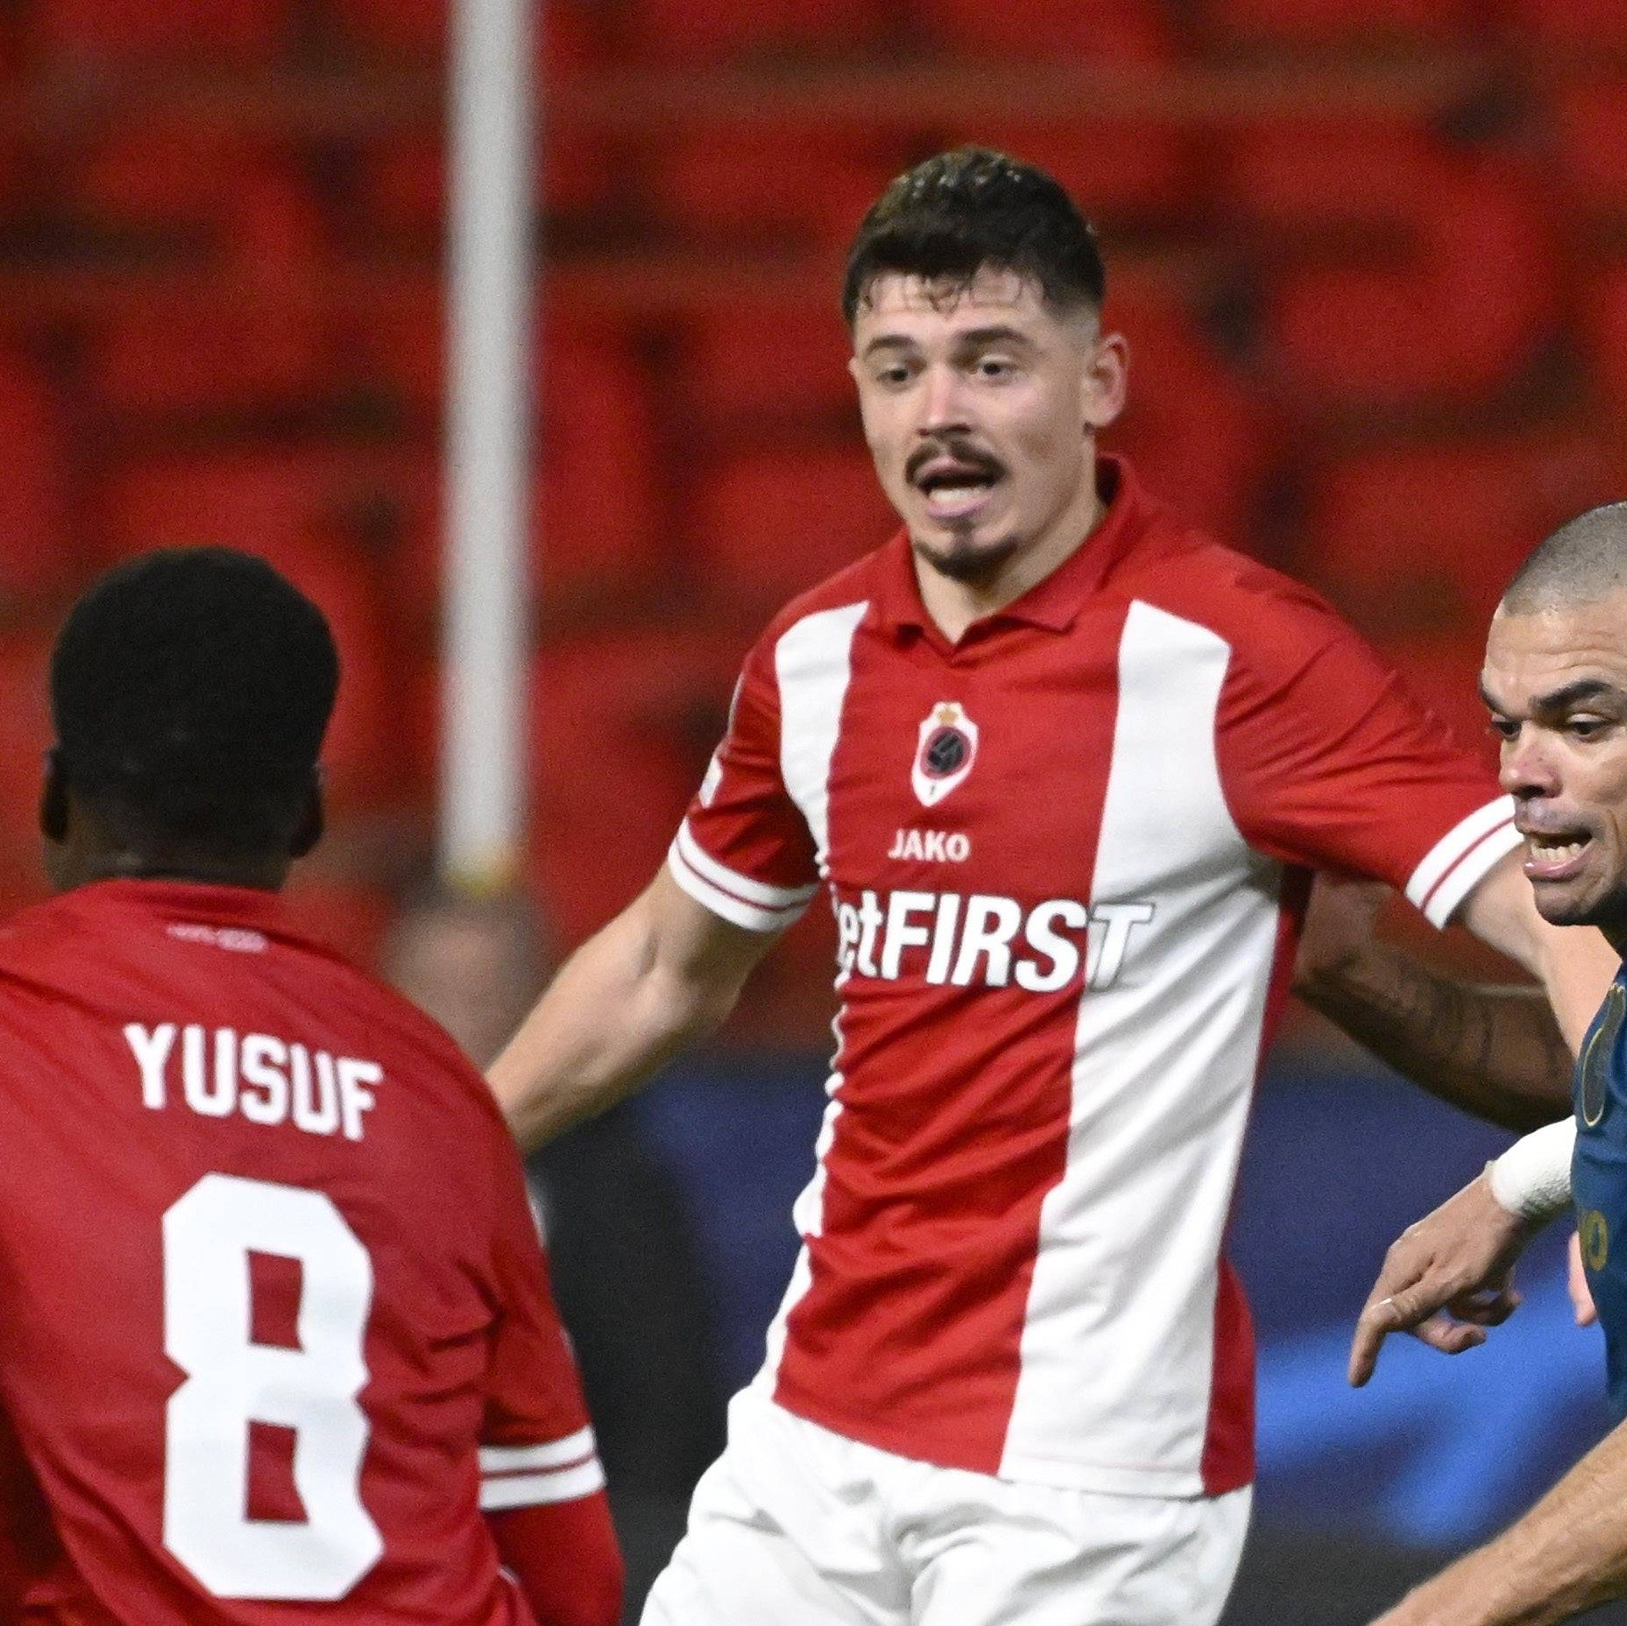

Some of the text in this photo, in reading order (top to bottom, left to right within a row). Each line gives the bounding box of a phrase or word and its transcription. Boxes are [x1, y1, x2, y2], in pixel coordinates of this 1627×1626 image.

[887, 828, 971, 862] JAKO
[836, 890, 1156, 992] etFIRST
[124, 1023, 384, 1142] YUSUF
[162, 1172, 385, 1600] 8
